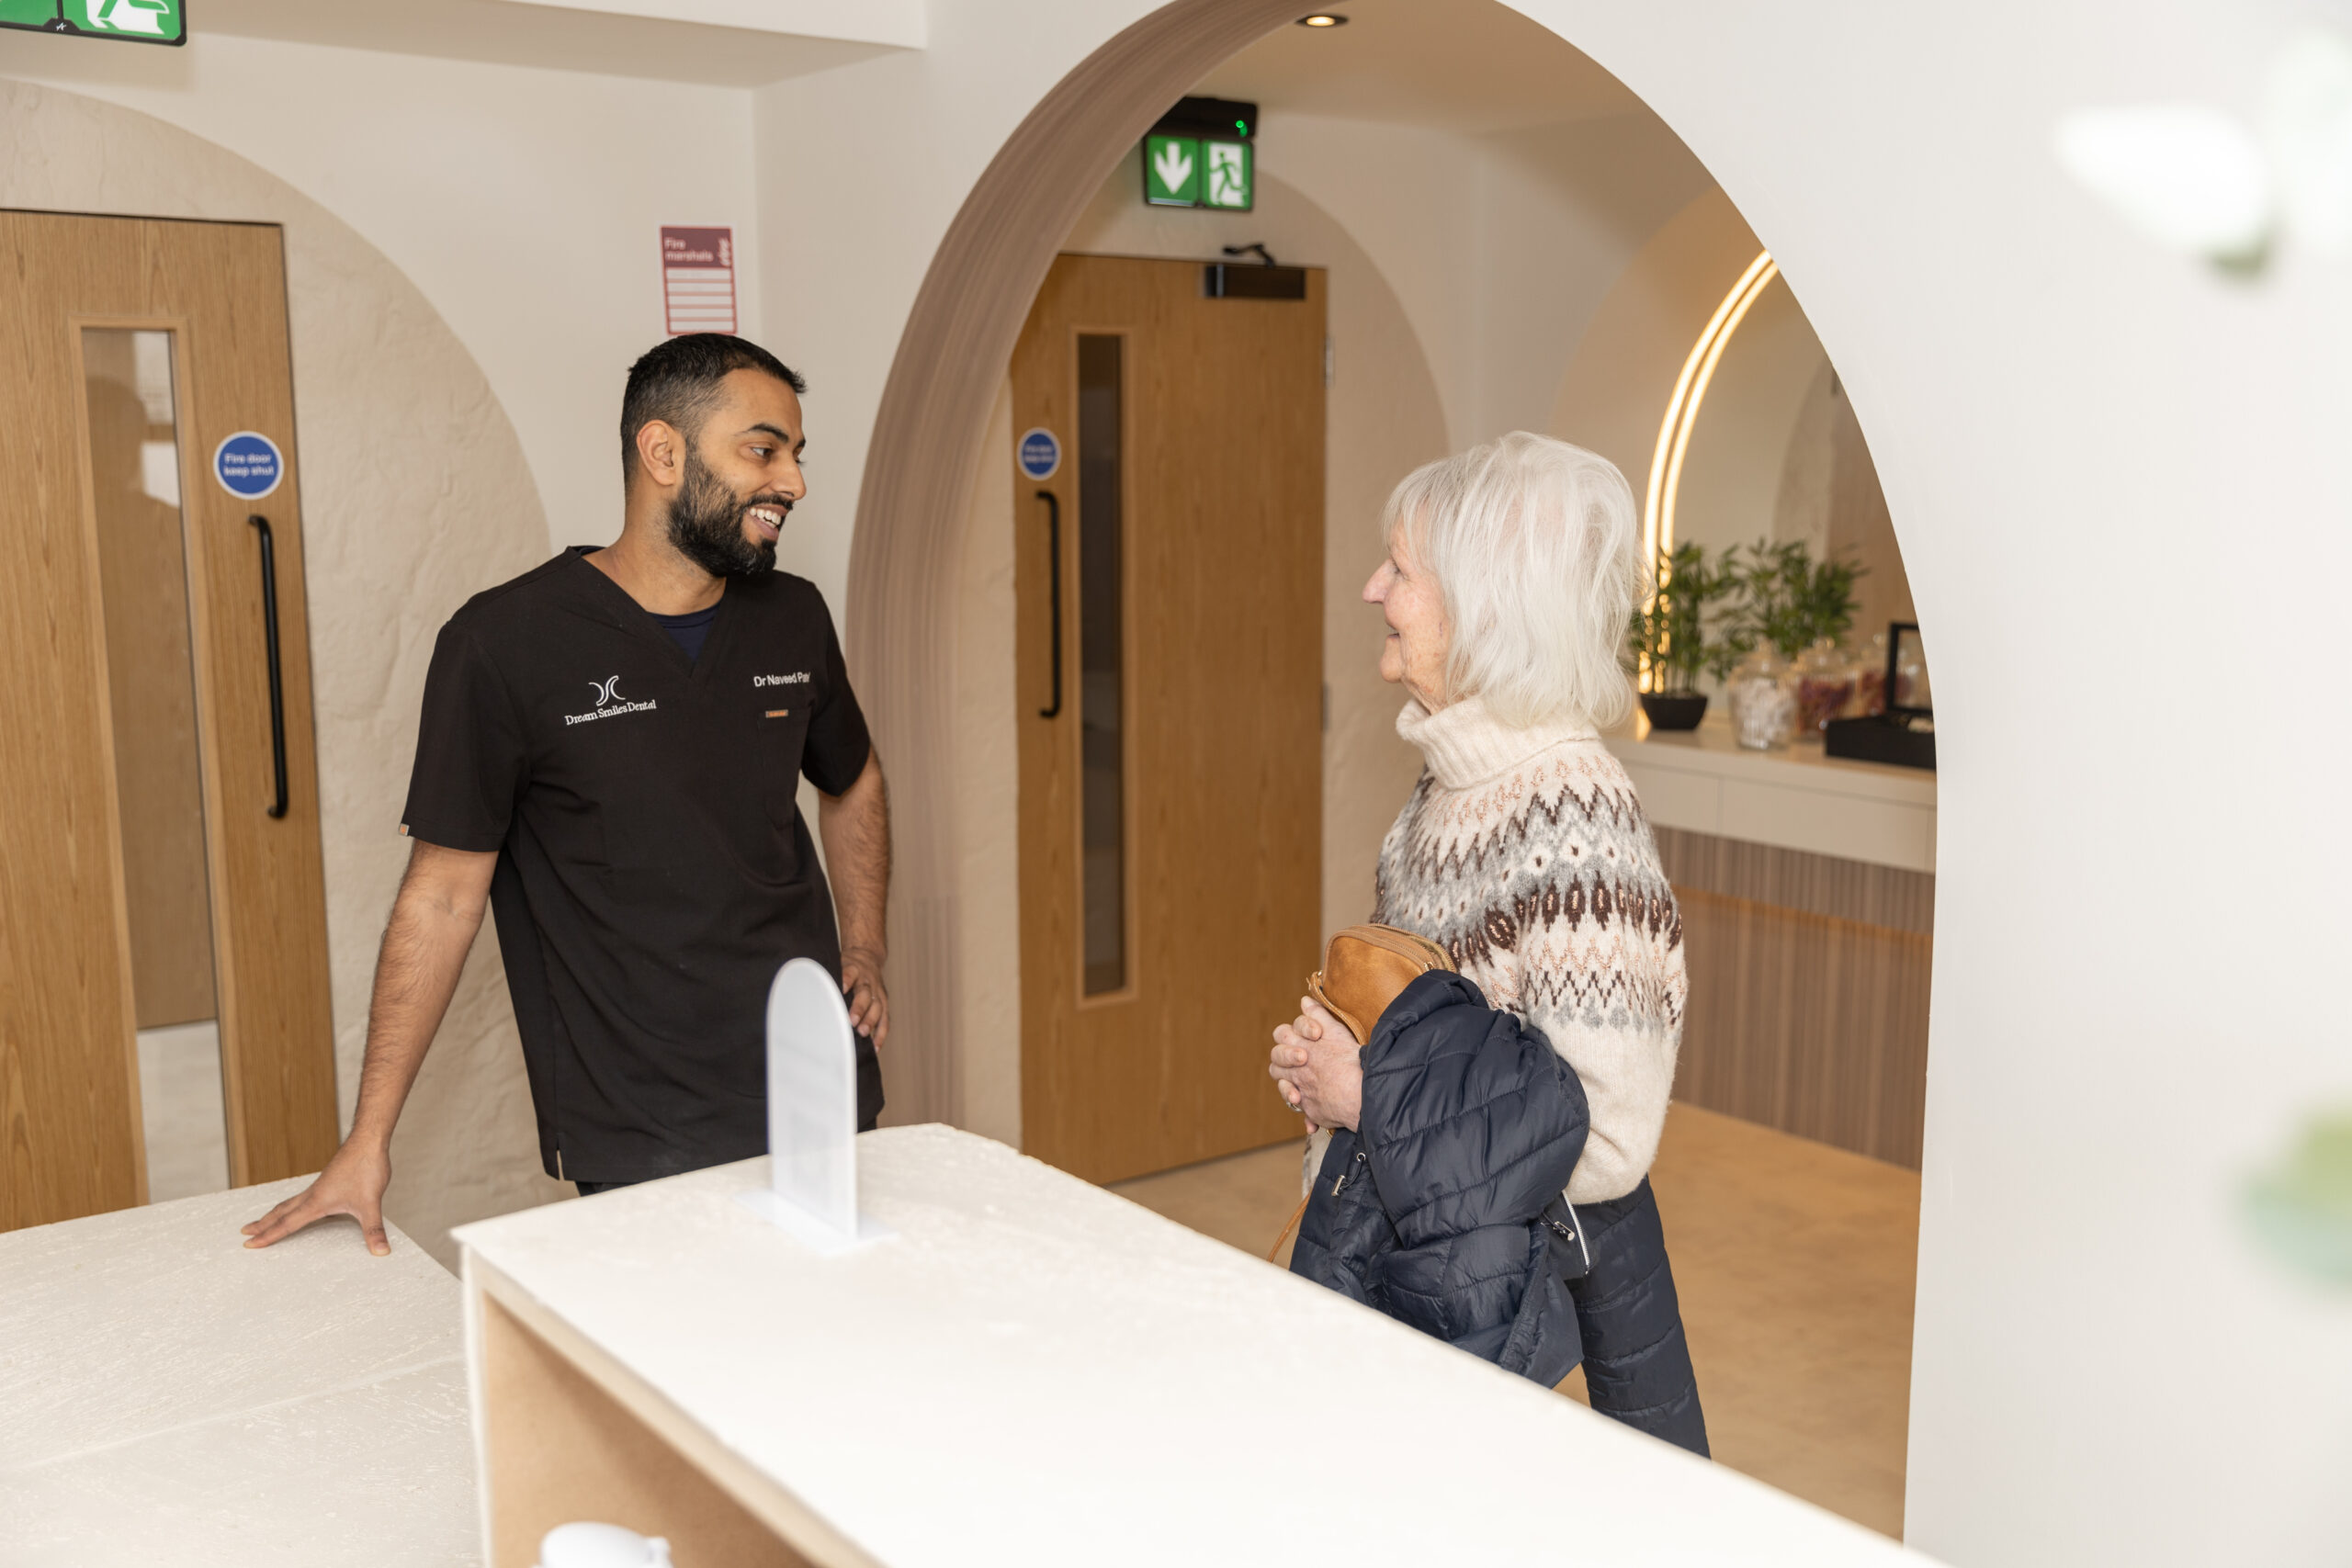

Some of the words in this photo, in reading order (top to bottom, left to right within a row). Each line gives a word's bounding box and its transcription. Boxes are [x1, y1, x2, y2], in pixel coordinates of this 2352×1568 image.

[665, 238, 685, 250] Fire
[224, 453, 245, 464] Fire
[247, 453, 271, 464] door
[223, 466, 249, 478] keep
[251, 465, 274, 476] shut
[753, 676, 766, 687] Dr
[766, 672, 797, 686] Naveed
[565, 712, 598, 726] Dream
[598, 705, 628, 718] Smiles
[627, 699, 657, 713] Dental
